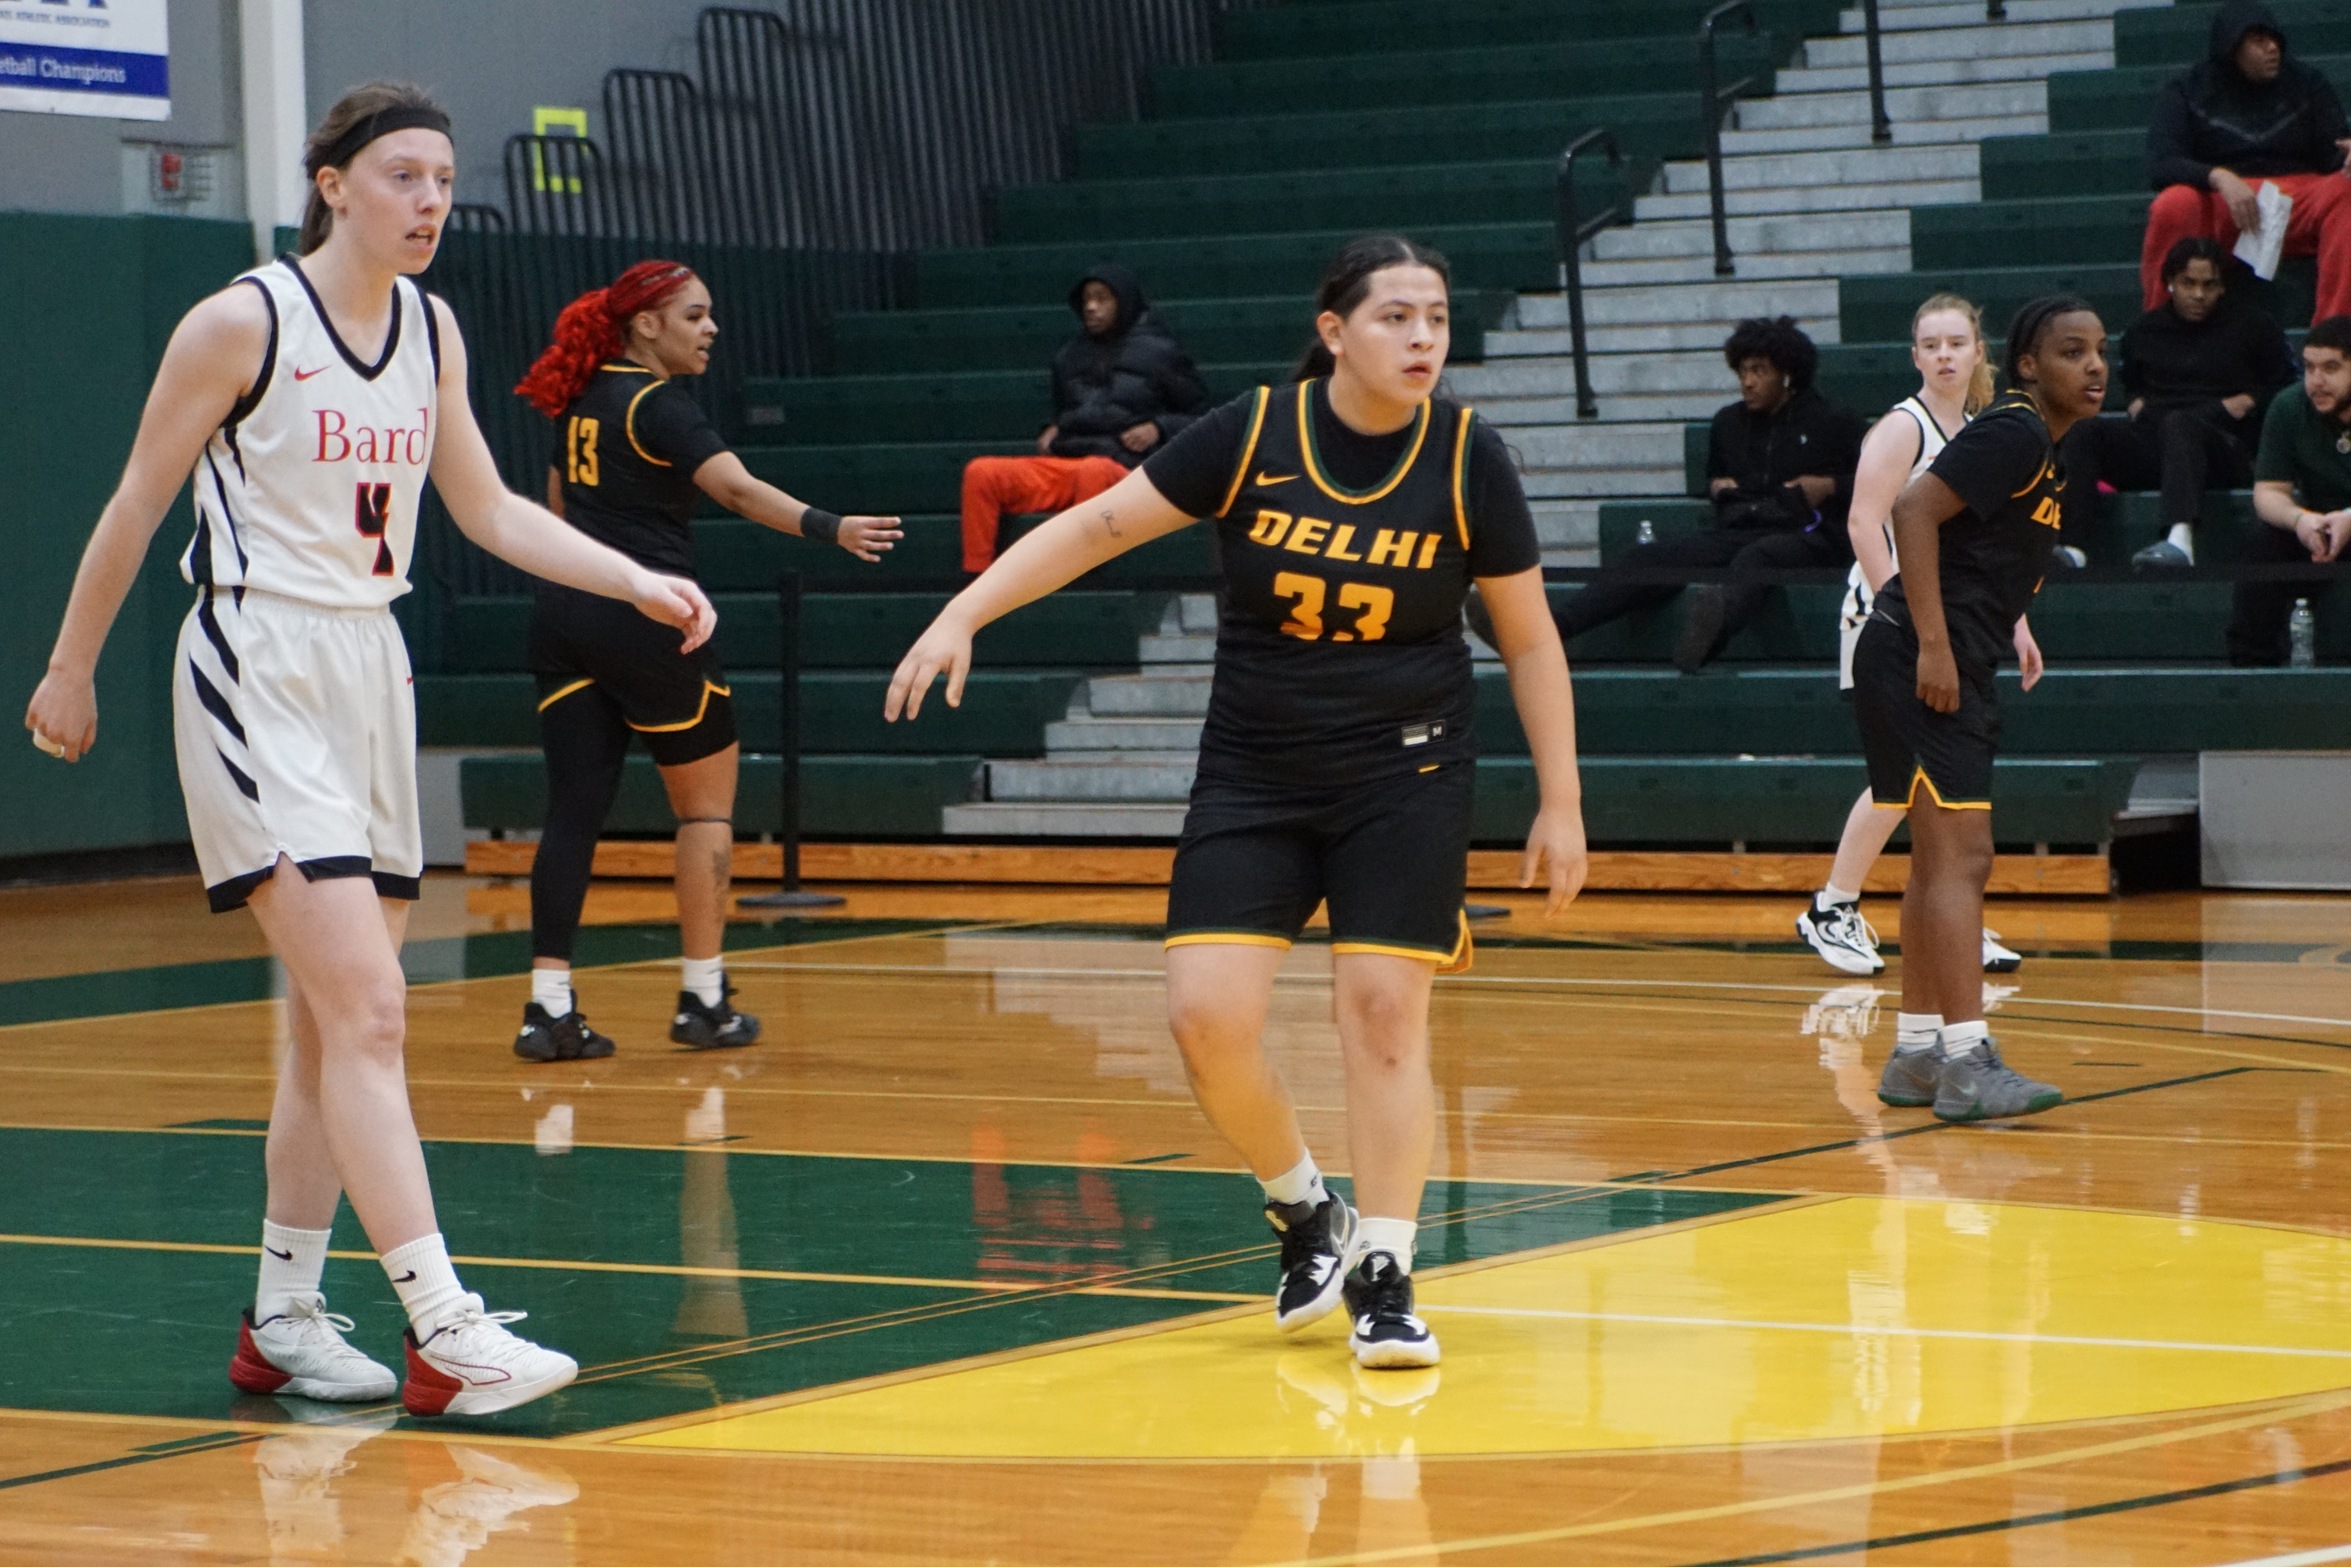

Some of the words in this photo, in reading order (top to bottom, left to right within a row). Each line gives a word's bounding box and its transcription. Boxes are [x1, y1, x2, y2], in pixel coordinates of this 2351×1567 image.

[40, 56, 126, 85] Champions
[311, 407, 428, 466] Bard
[567, 415, 599, 487] 13
[355, 482, 395, 577] 4
[1248, 509, 1442, 569] DELHI
[1273, 571, 1395, 642] 33
